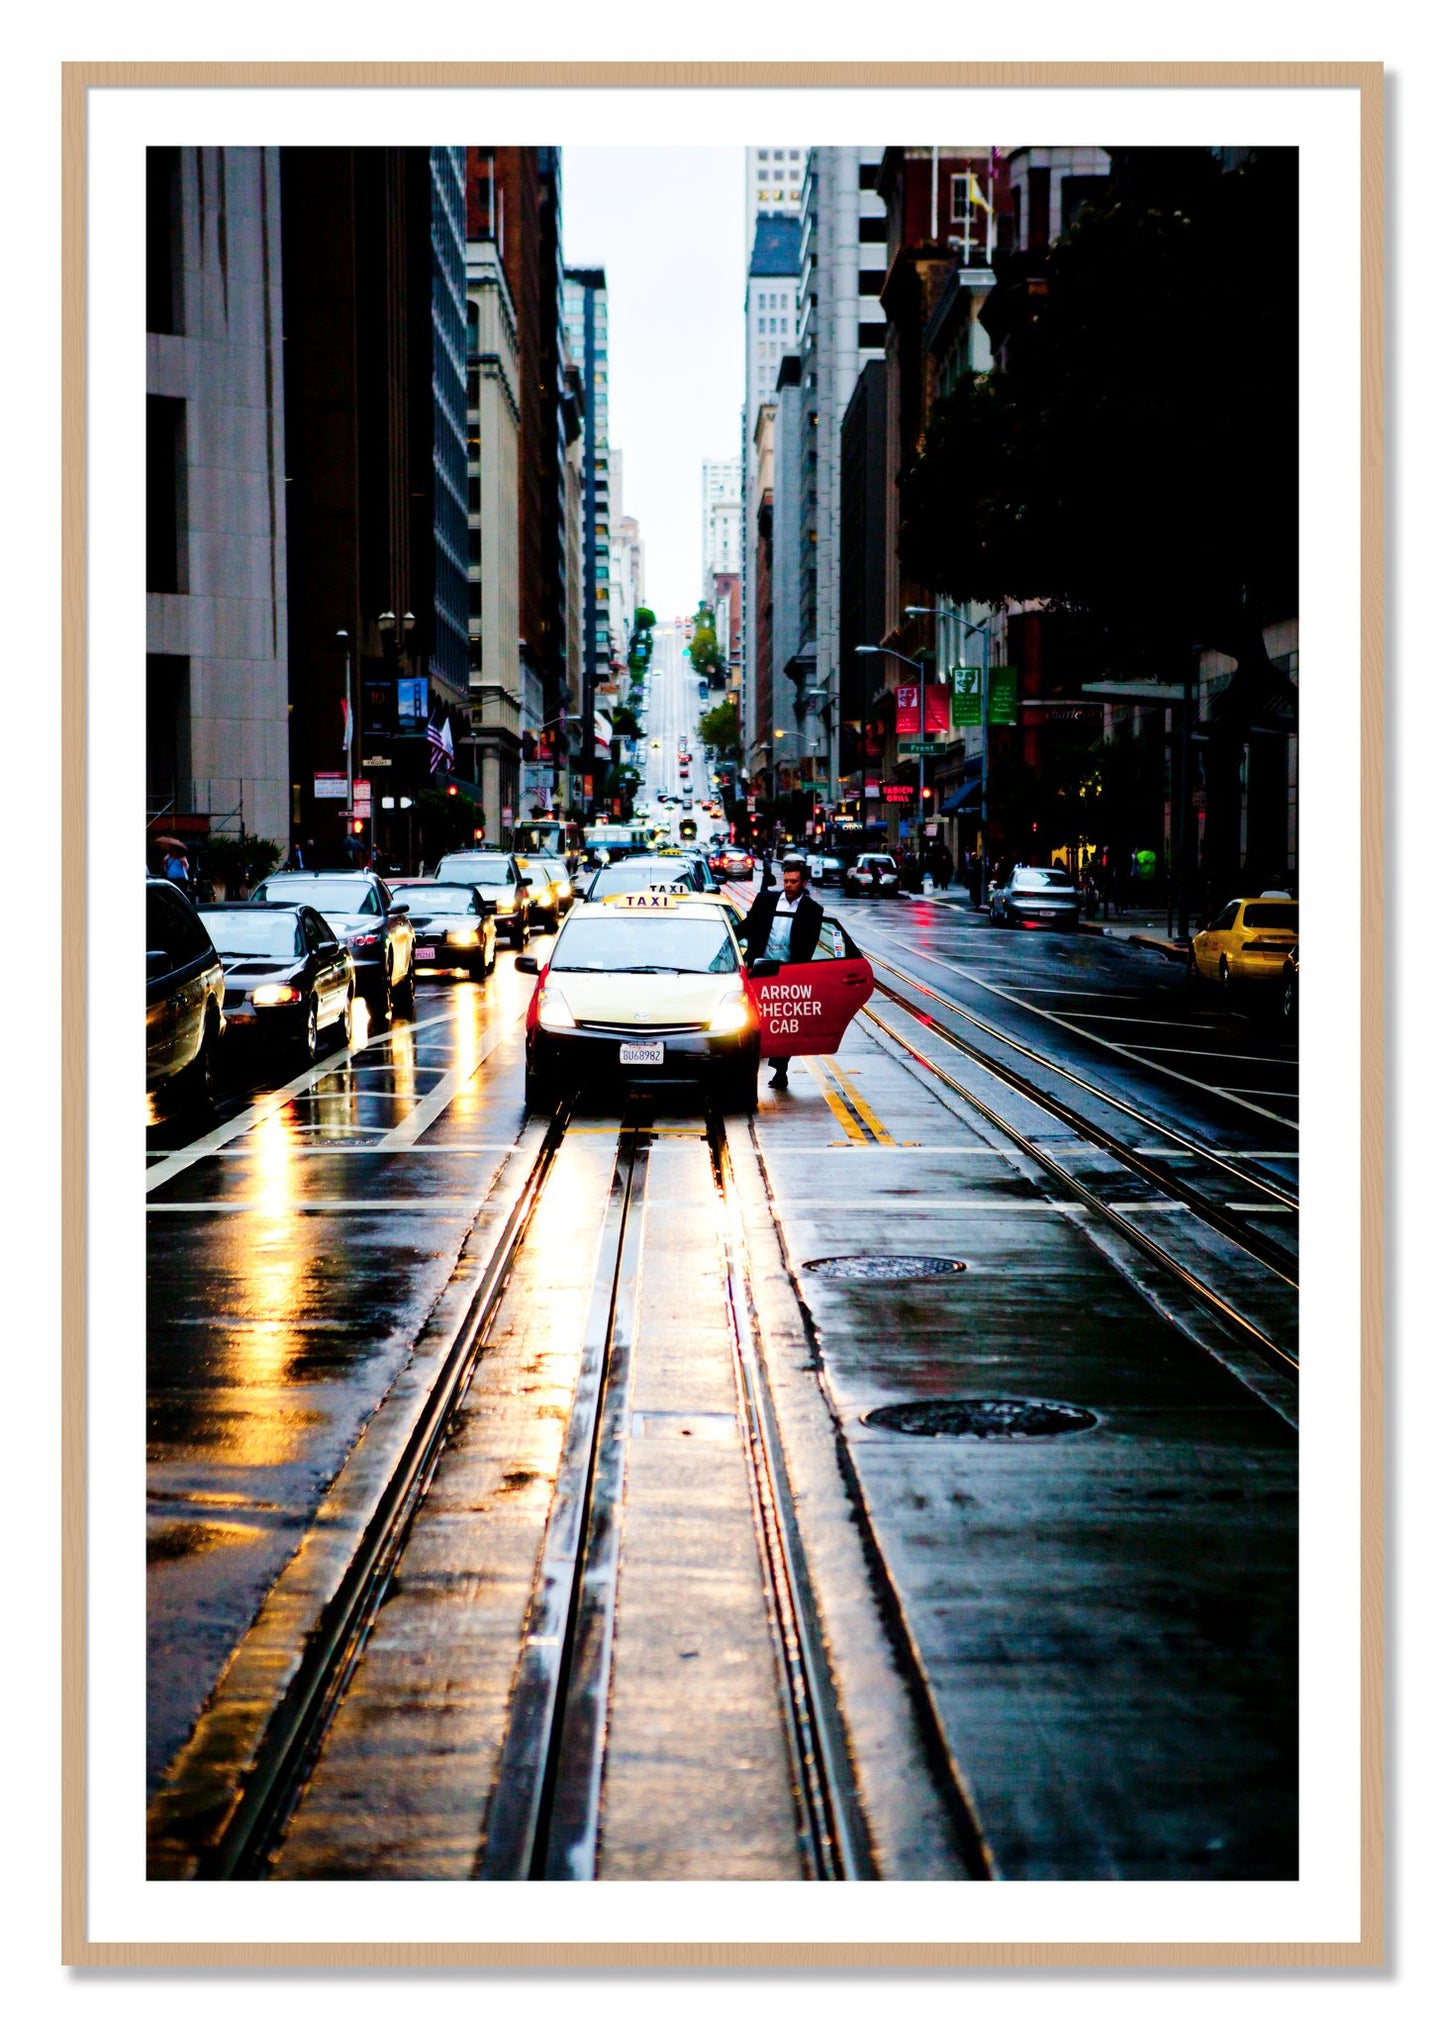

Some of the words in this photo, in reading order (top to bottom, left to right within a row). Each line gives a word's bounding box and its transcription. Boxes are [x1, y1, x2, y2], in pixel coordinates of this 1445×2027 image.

[910, 744, 934, 753] Front
[883, 785, 914, 794] TADICH
[886, 794, 910, 803] GRILL
[650, 885, 684, 893] TAXI
[626, 896, 668, 907] TAXI
[760, 984, 812, 1000] ARROW
[769, 1018, 800, 1034] CAB
